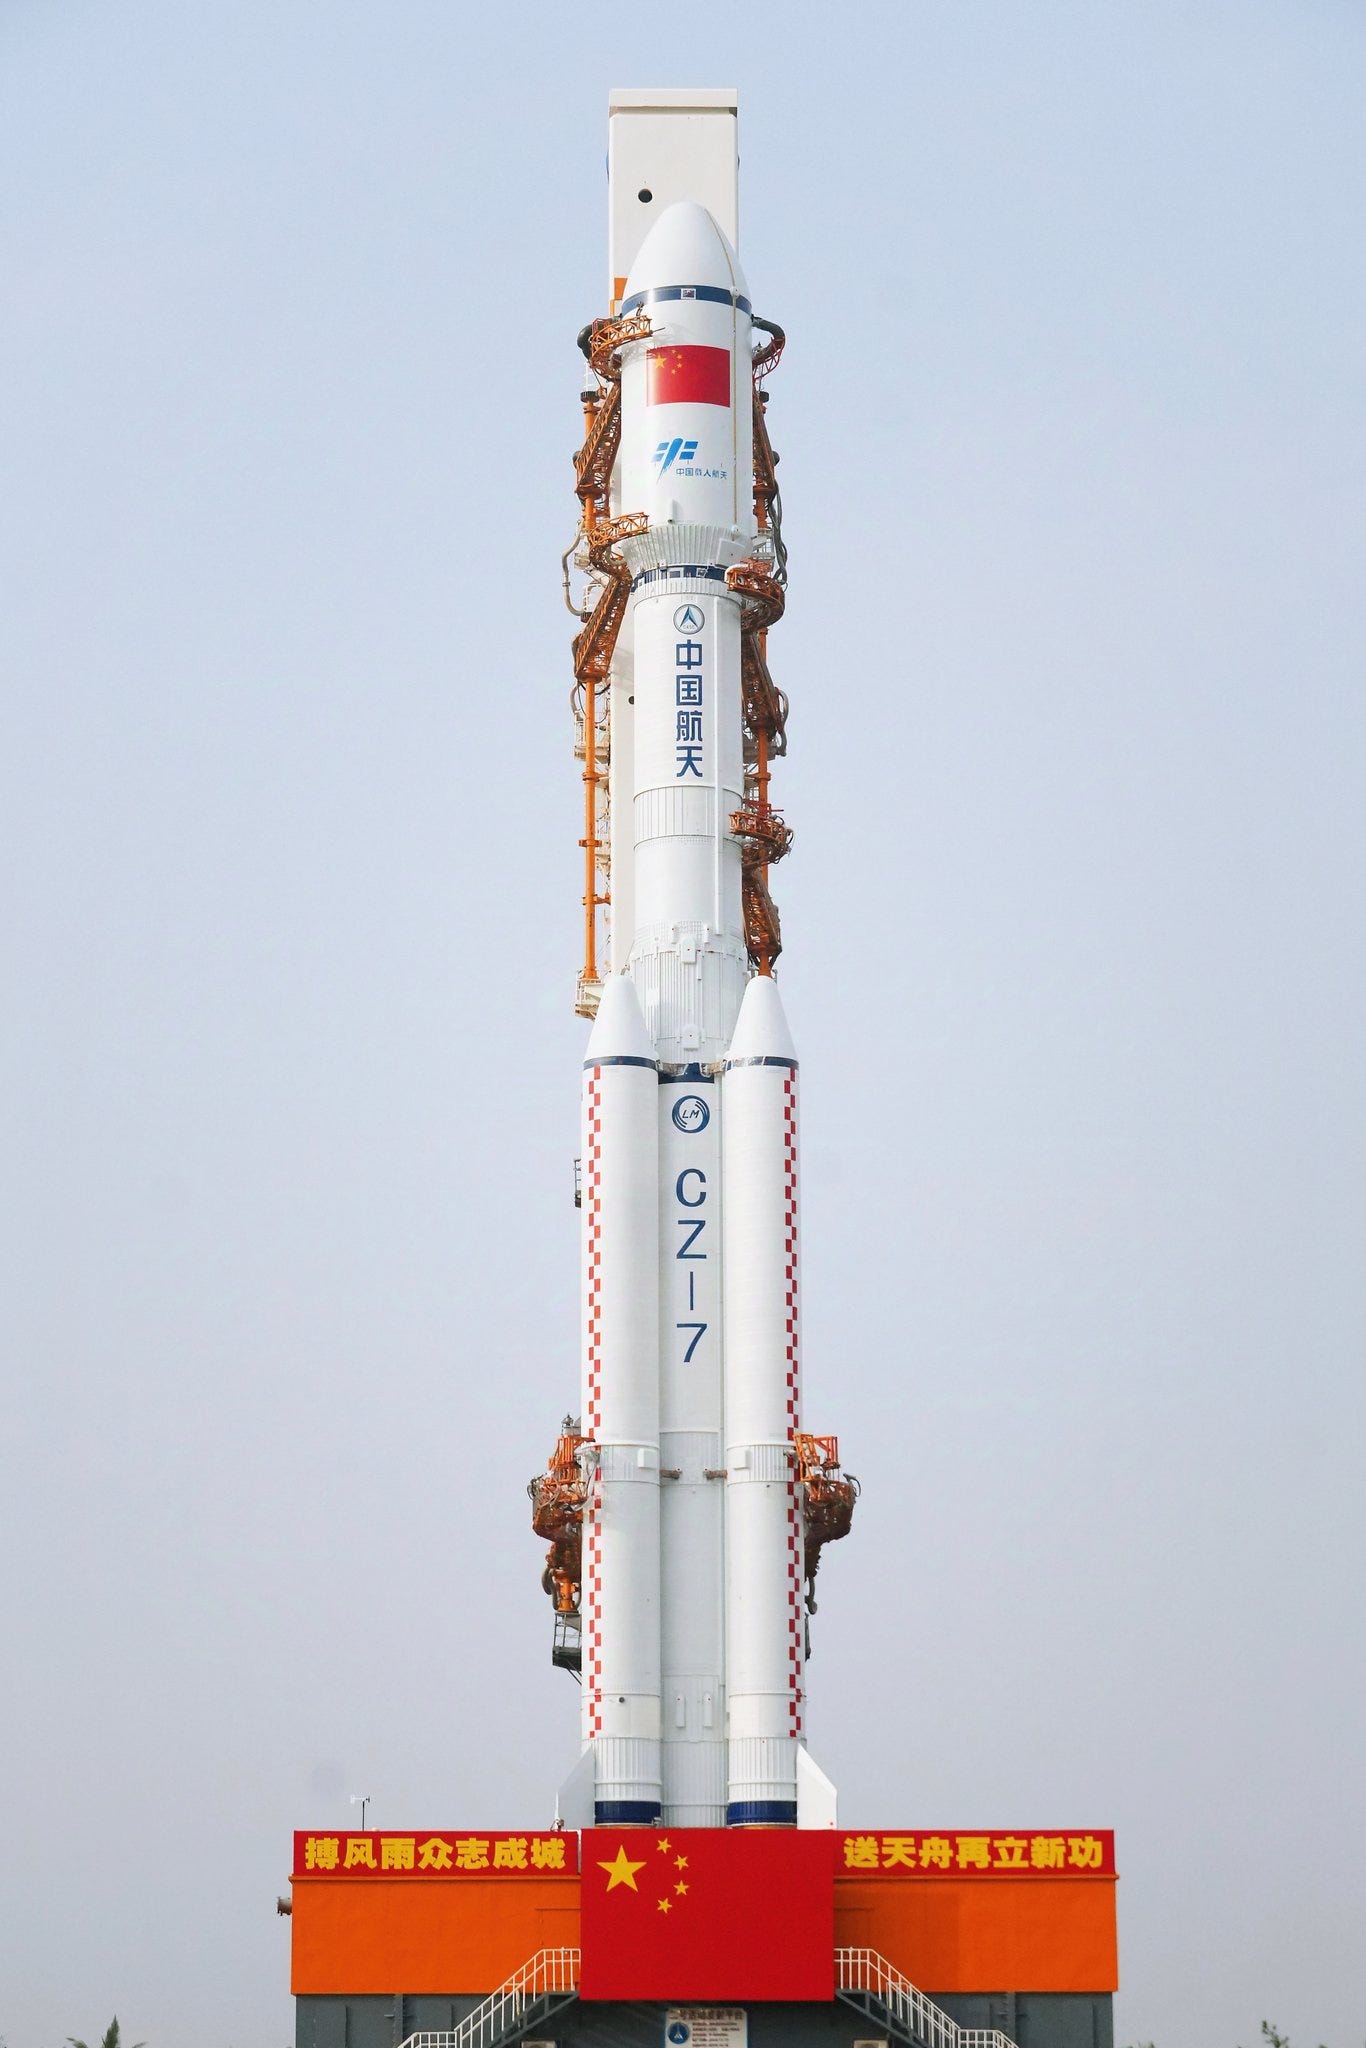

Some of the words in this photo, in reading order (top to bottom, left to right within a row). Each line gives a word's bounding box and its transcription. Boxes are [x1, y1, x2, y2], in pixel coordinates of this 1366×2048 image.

[675, 639, 703, 778] 中国航天
[682, 1109, 700, 1119] LM
[305, 1837, 566, 1870] 搏风雨众志成城
[843, 1836, 1103, 1868] 送天舟再立新功
